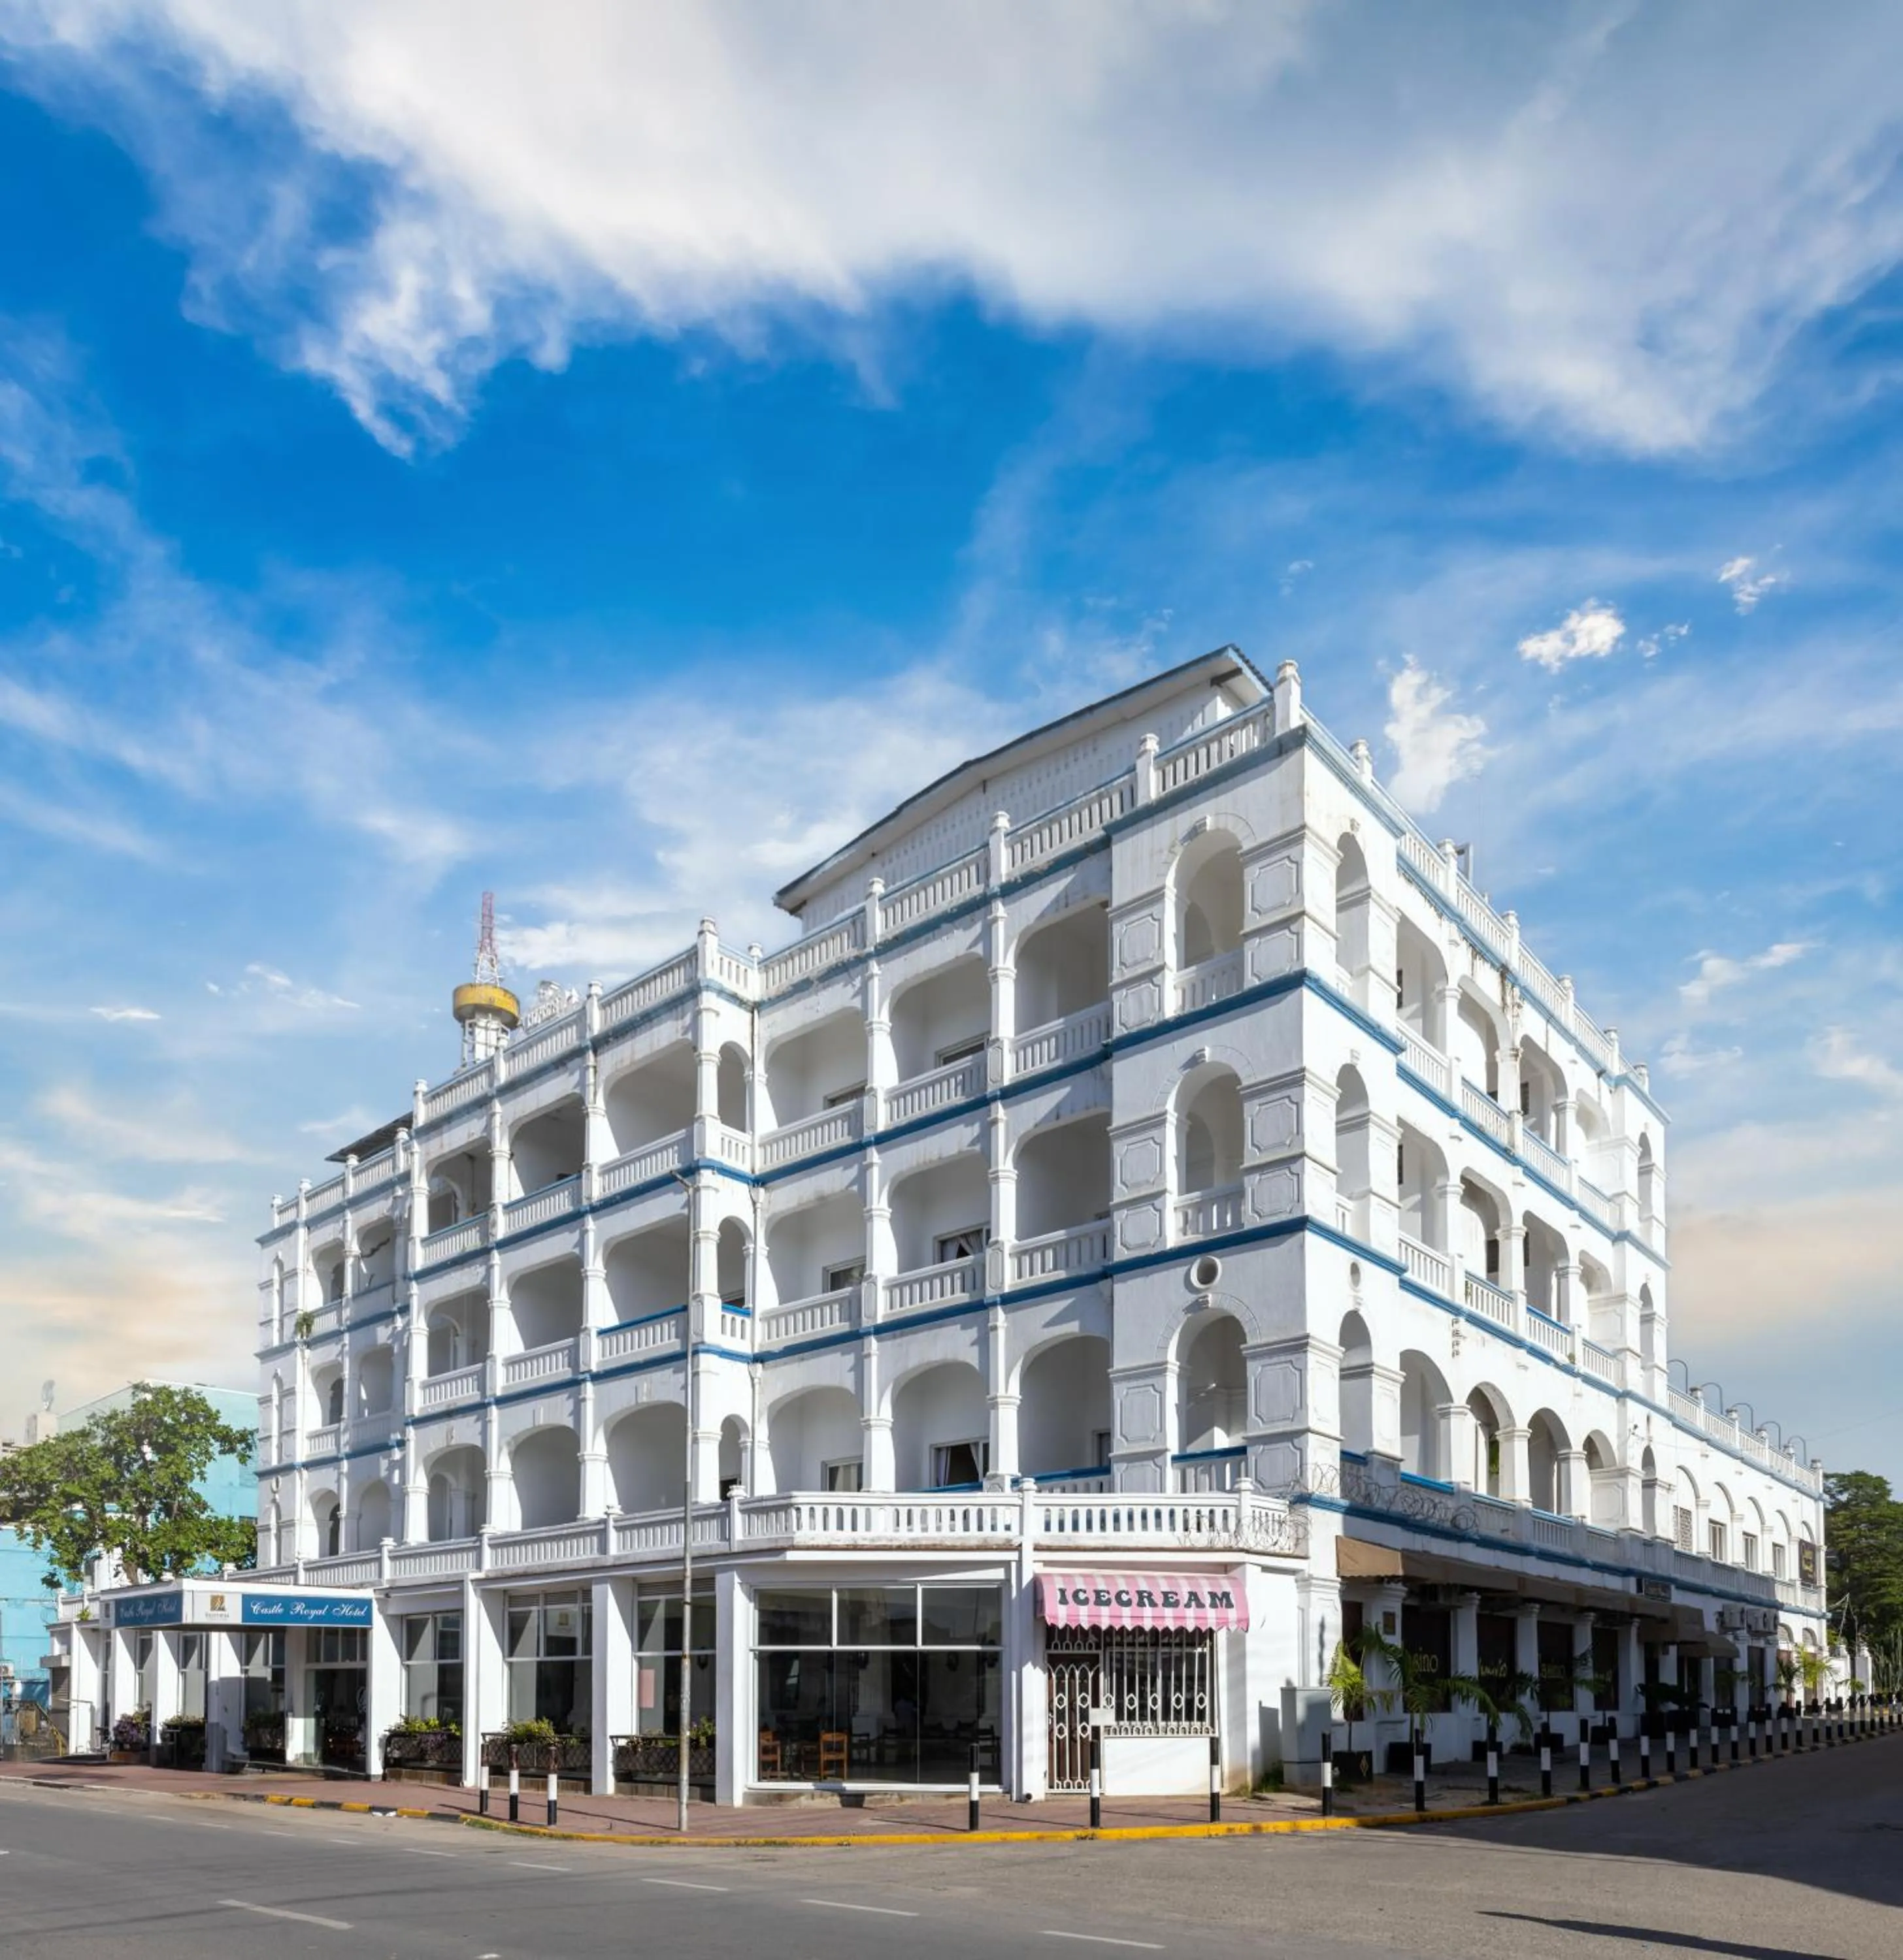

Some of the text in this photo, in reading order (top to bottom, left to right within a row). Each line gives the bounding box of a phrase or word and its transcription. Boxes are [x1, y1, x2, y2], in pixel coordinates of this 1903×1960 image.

[1057, 1588, 1234, 1609] ICECREAM
[250, 1601, 369, 1620] Castle Royal Hotel
